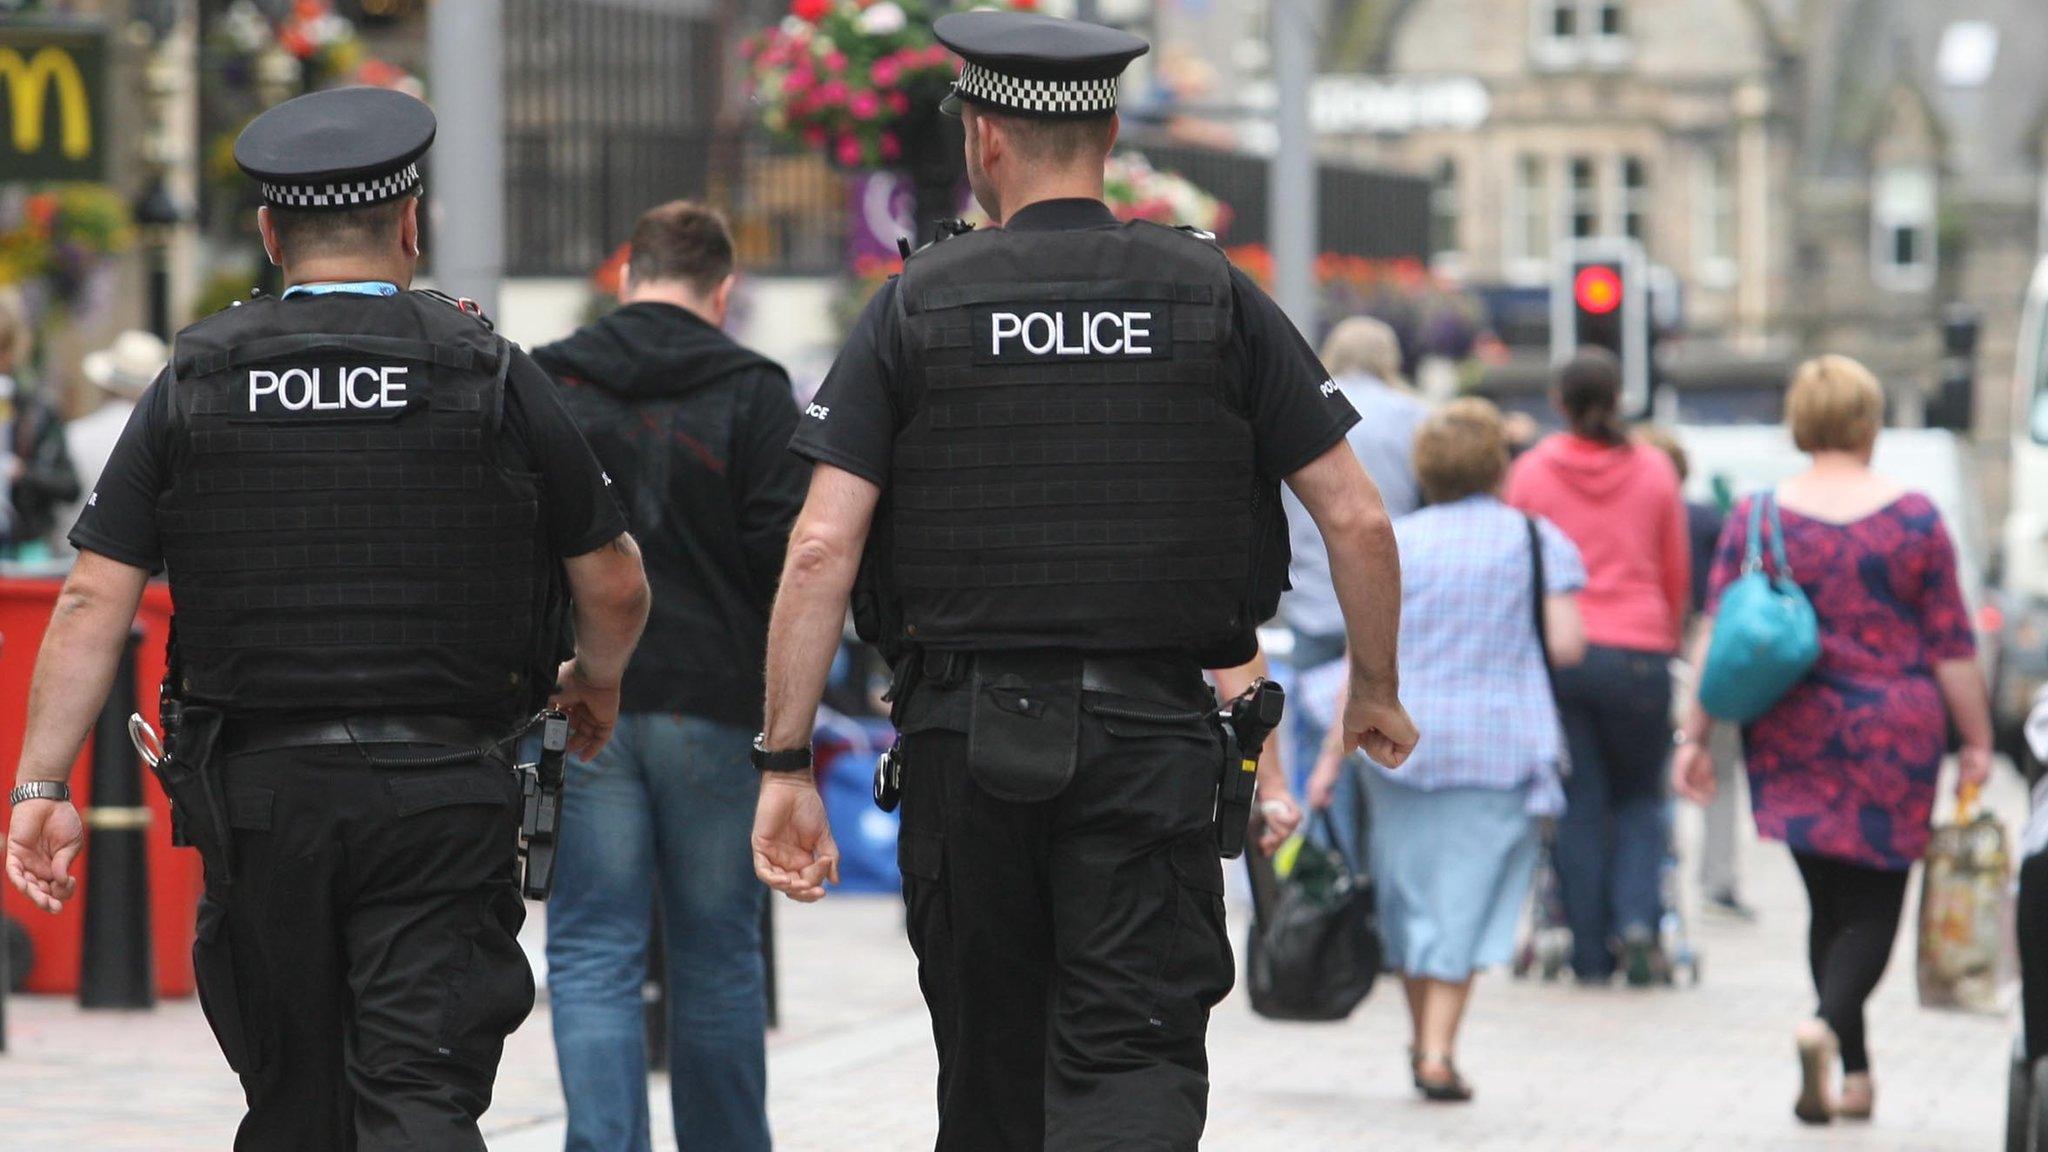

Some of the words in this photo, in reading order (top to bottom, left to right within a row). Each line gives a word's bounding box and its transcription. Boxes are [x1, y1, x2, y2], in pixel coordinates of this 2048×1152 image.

[991, 311, 1152, 356] POLICE
[249, 366, 408, 412] POLICE
[1320, 378, 1337, 398] POL
[805, 401, 830, 420] ICE
